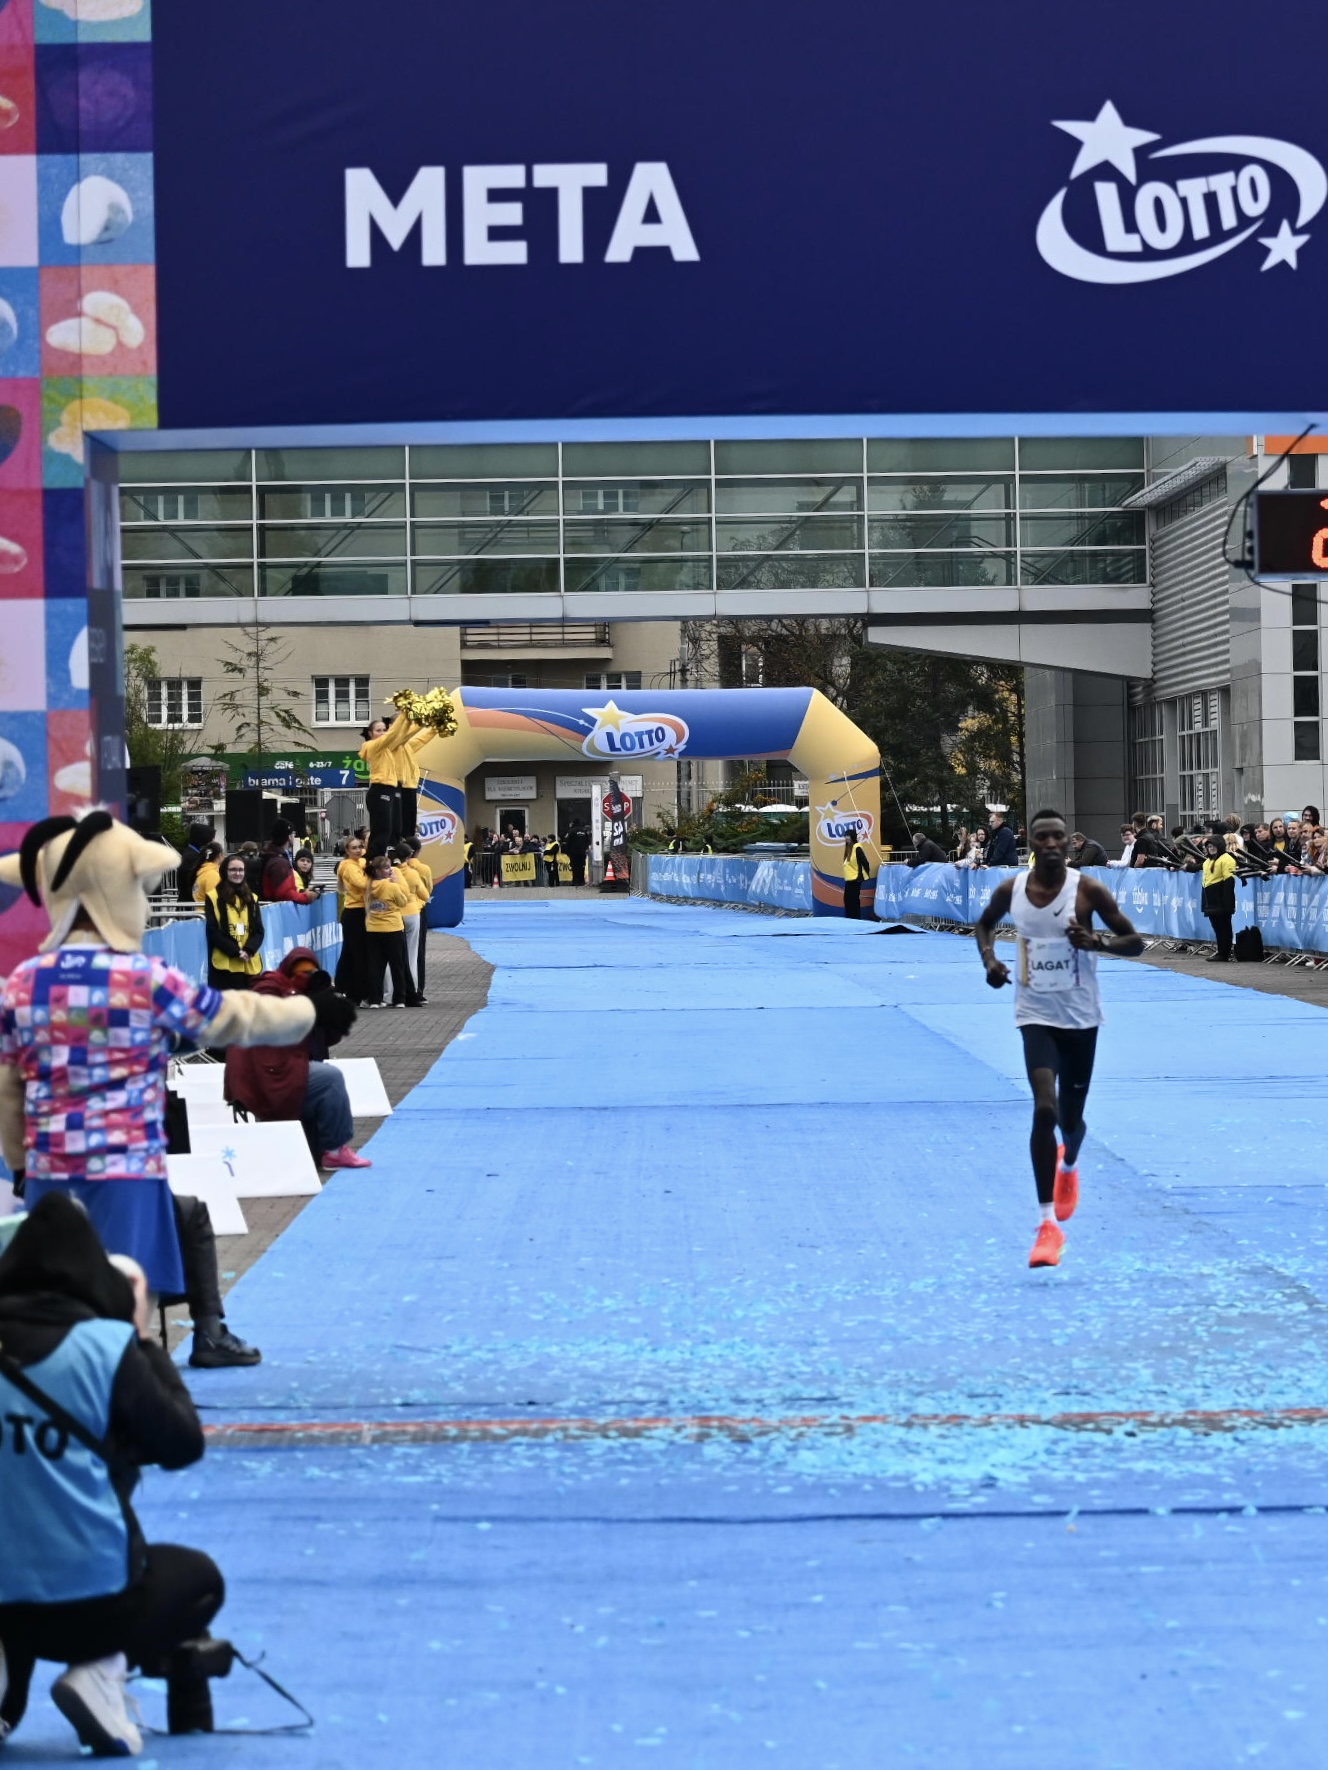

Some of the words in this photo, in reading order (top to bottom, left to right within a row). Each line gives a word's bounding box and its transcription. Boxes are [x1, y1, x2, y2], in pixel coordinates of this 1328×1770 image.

[345, 161, 701, 268] META
[1093, 163, 1271, 253] LOTTO
[606, 726, 666, 752] LOTTO
[248, 776, 286, 786] brama
[339, 770, 350, 785] 7
[603, 802, 630, 811] SP
[418, 818, 446, 837] OTTO
[1031, 960, 1070, 971] LAGAT
[0, 1412, 69, 1461] TO
